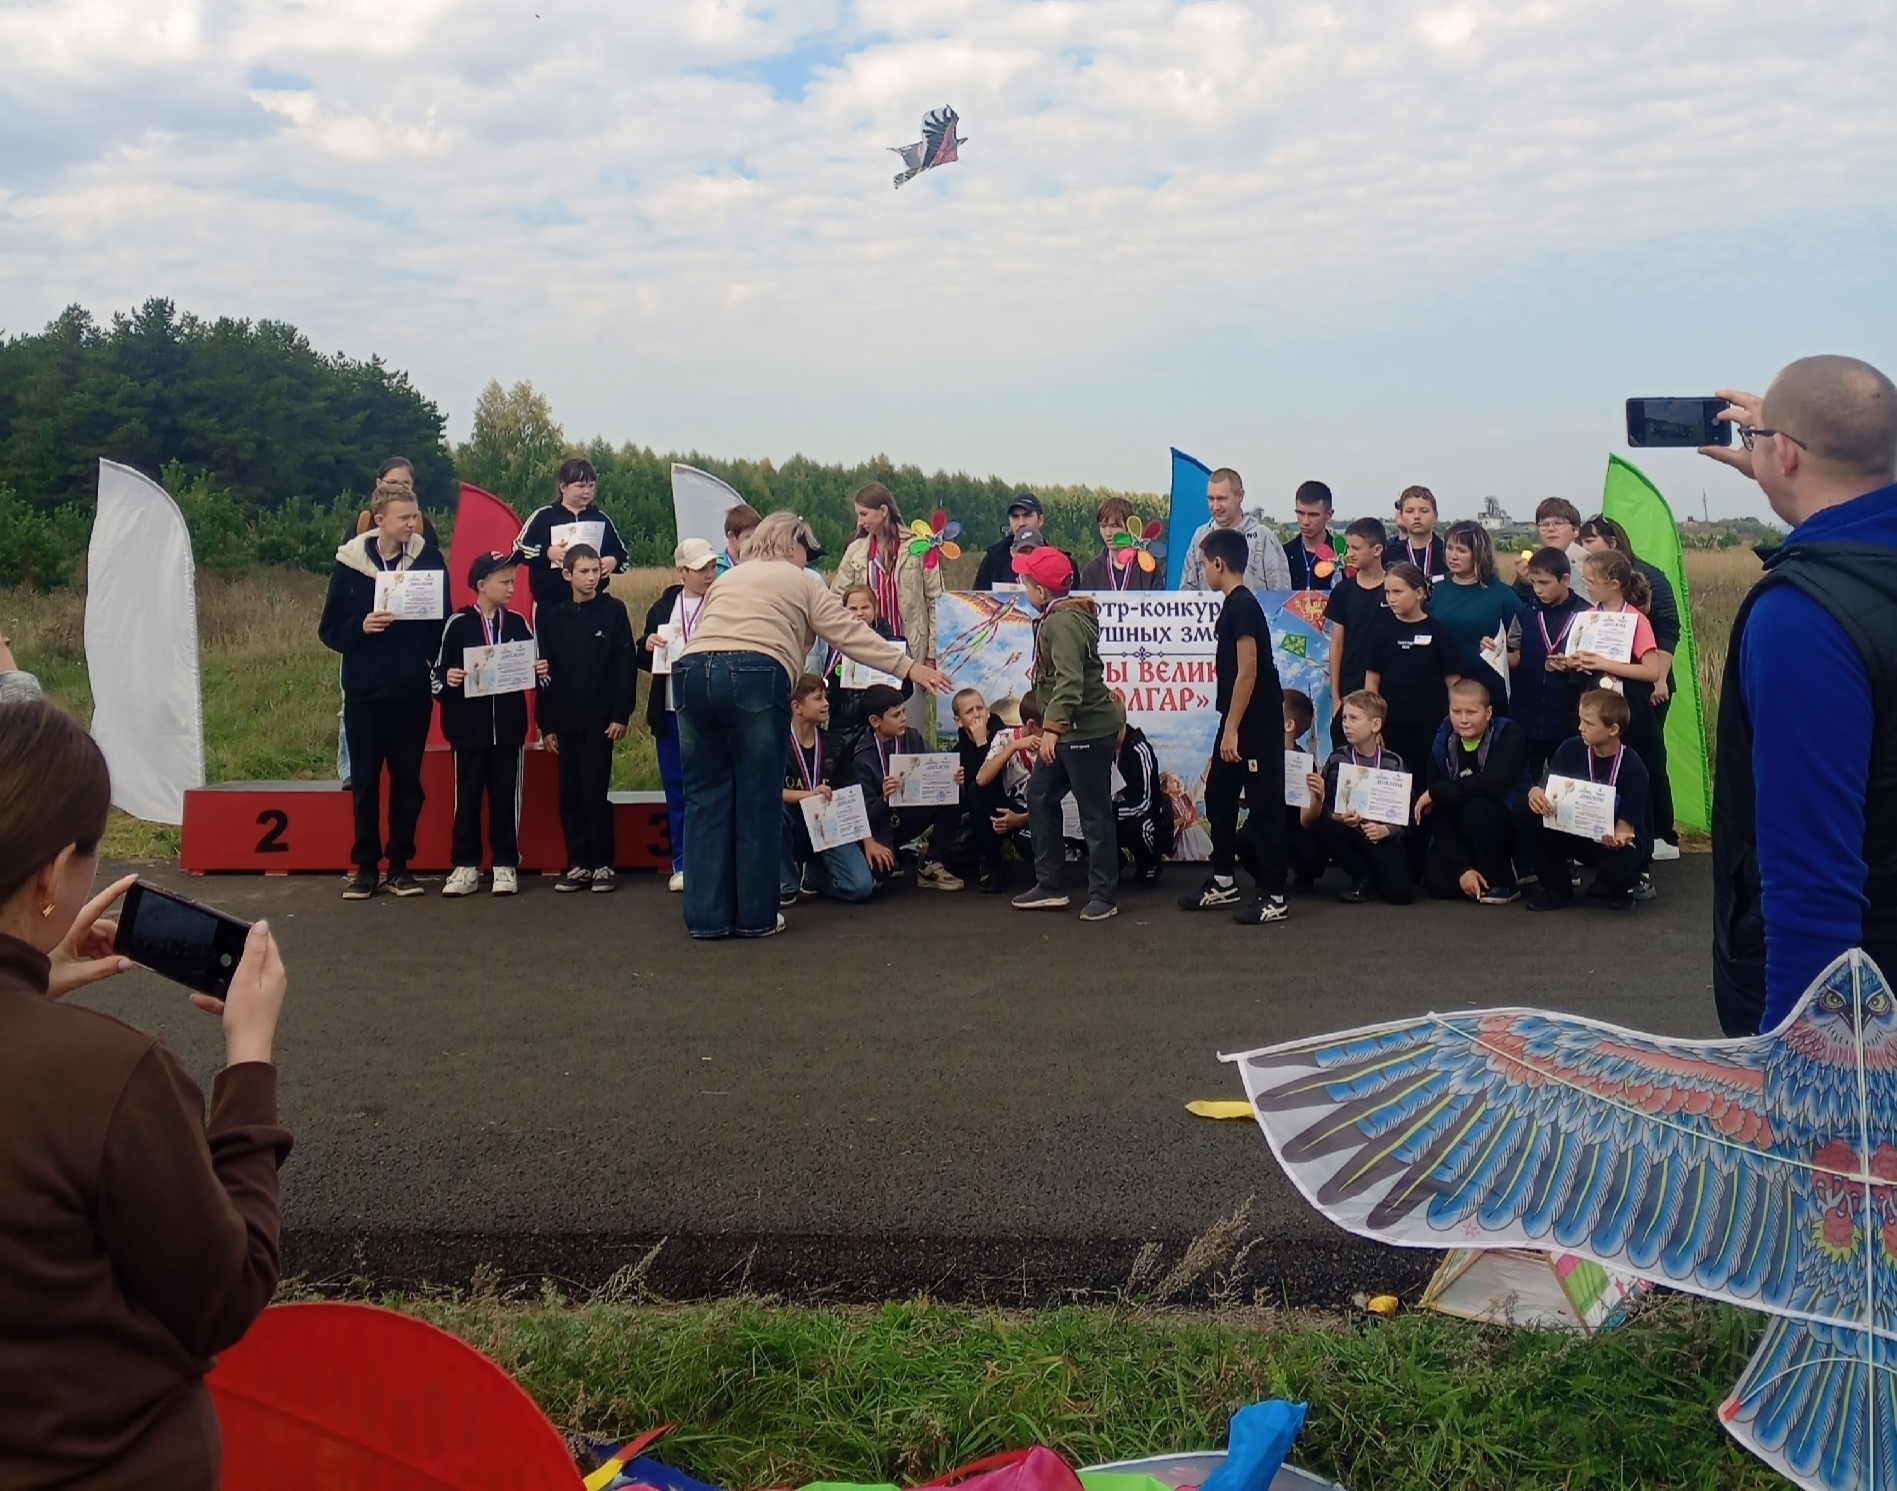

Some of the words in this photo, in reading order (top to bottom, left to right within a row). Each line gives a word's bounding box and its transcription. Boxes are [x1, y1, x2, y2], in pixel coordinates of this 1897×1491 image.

[1094, 601, 1221, 623] отр-конкур
[1138, 661, 1217, 683] ВЕЛИК
[254, 809, 288, 853] 2
[647, 812, 673, 857] 3
